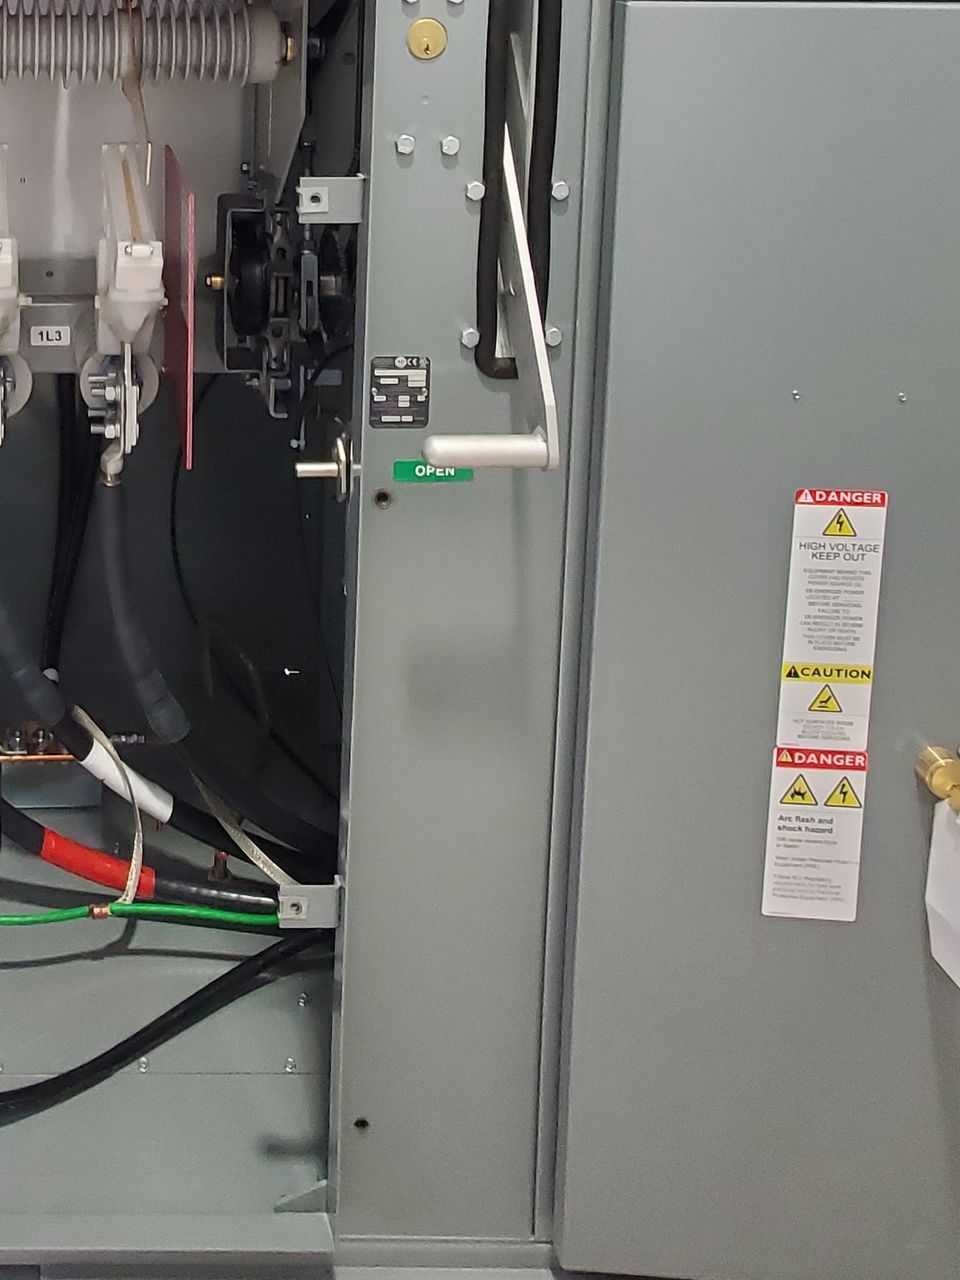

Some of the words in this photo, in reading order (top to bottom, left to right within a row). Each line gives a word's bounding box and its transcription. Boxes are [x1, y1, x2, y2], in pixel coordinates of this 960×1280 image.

[38, 330, 62, 342] 1L3
[415, 465, 454, 476] OPEN
[815, 491, 881, 503] DANGER
[799, 542, 826, 550] HIGH
[829, 543, 880, 553] VOLTAGE
[811, 552, 840, 560] KEEP
[843, 553, 866, 561] OUT
[801, 667, 871, 679] CAUTION
[794, 752, 865, 766] DANGER
[795, 815, 815, 823] flash
[777, 824, 802, 832] shock
[804, 826, 833, 834] hazard
